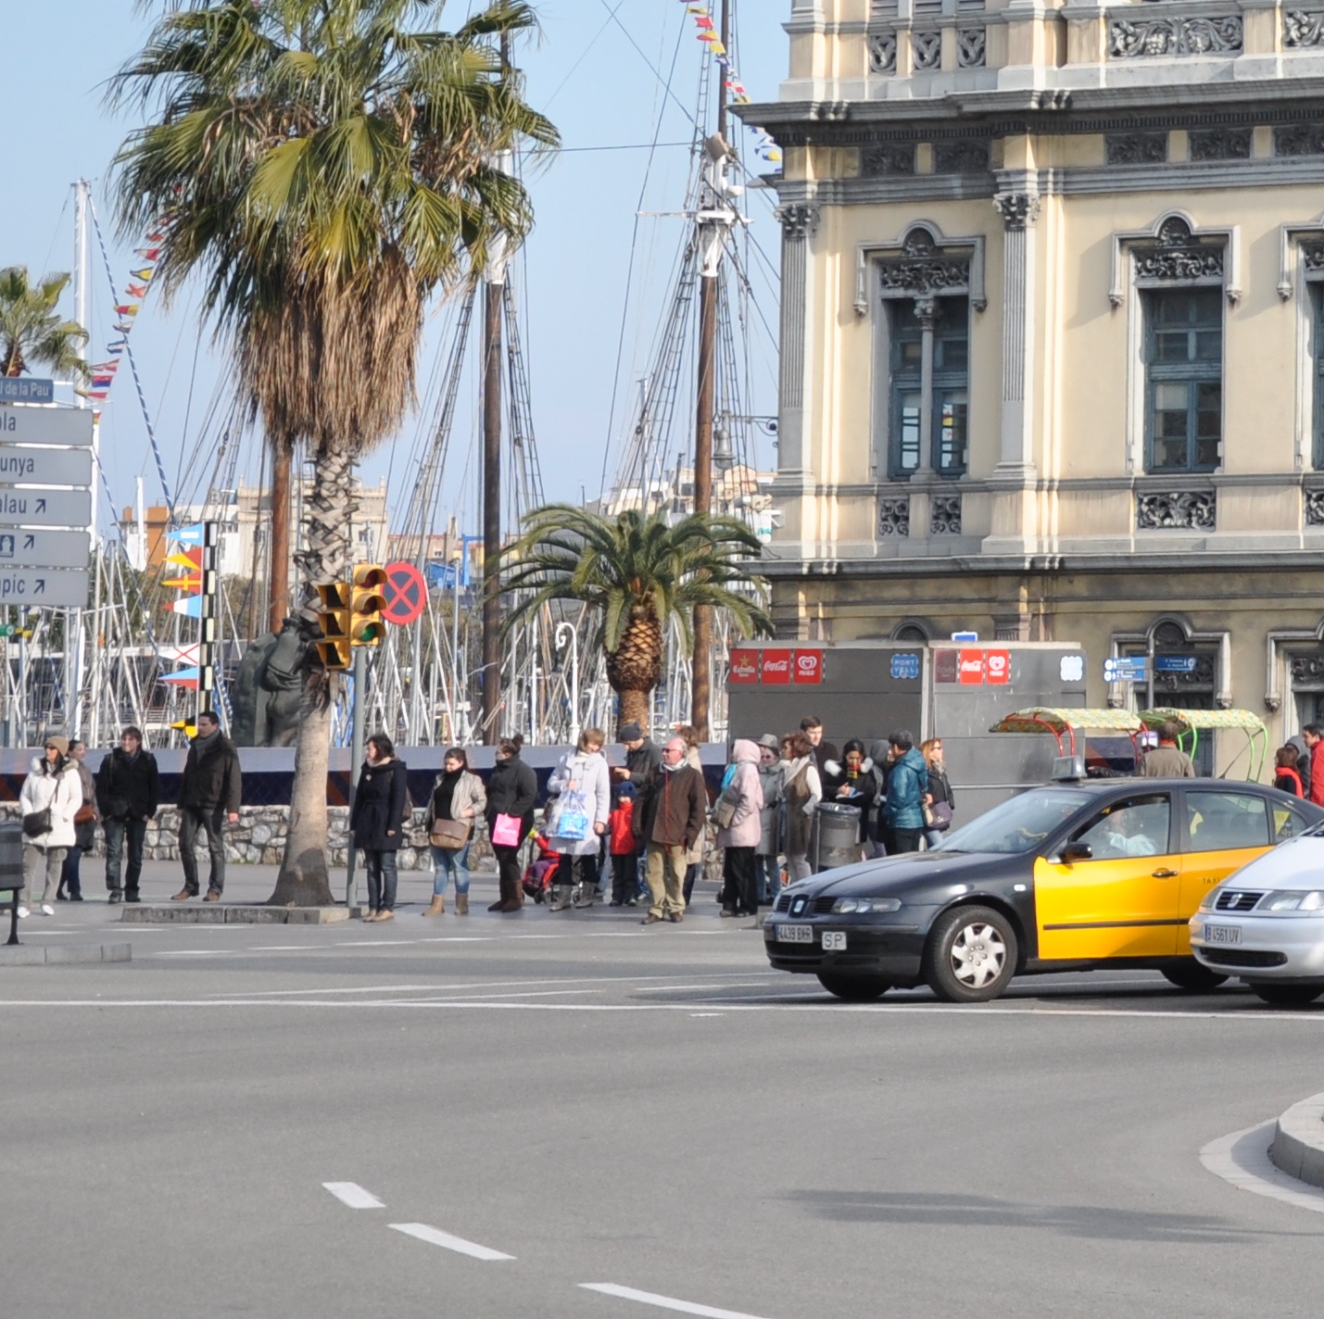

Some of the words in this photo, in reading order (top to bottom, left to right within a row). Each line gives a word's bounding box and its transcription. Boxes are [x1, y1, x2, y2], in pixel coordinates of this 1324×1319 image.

[4, 381, 18, 396] de
[19, 382, 29, 397] la
[30, 382, 49, 397] Pau
[0, 411, 16, 431] la
[0, 573, 25, 598] pic
[824, 933, 844, 949] SP
[1229, 929, 1240, 943] UV
